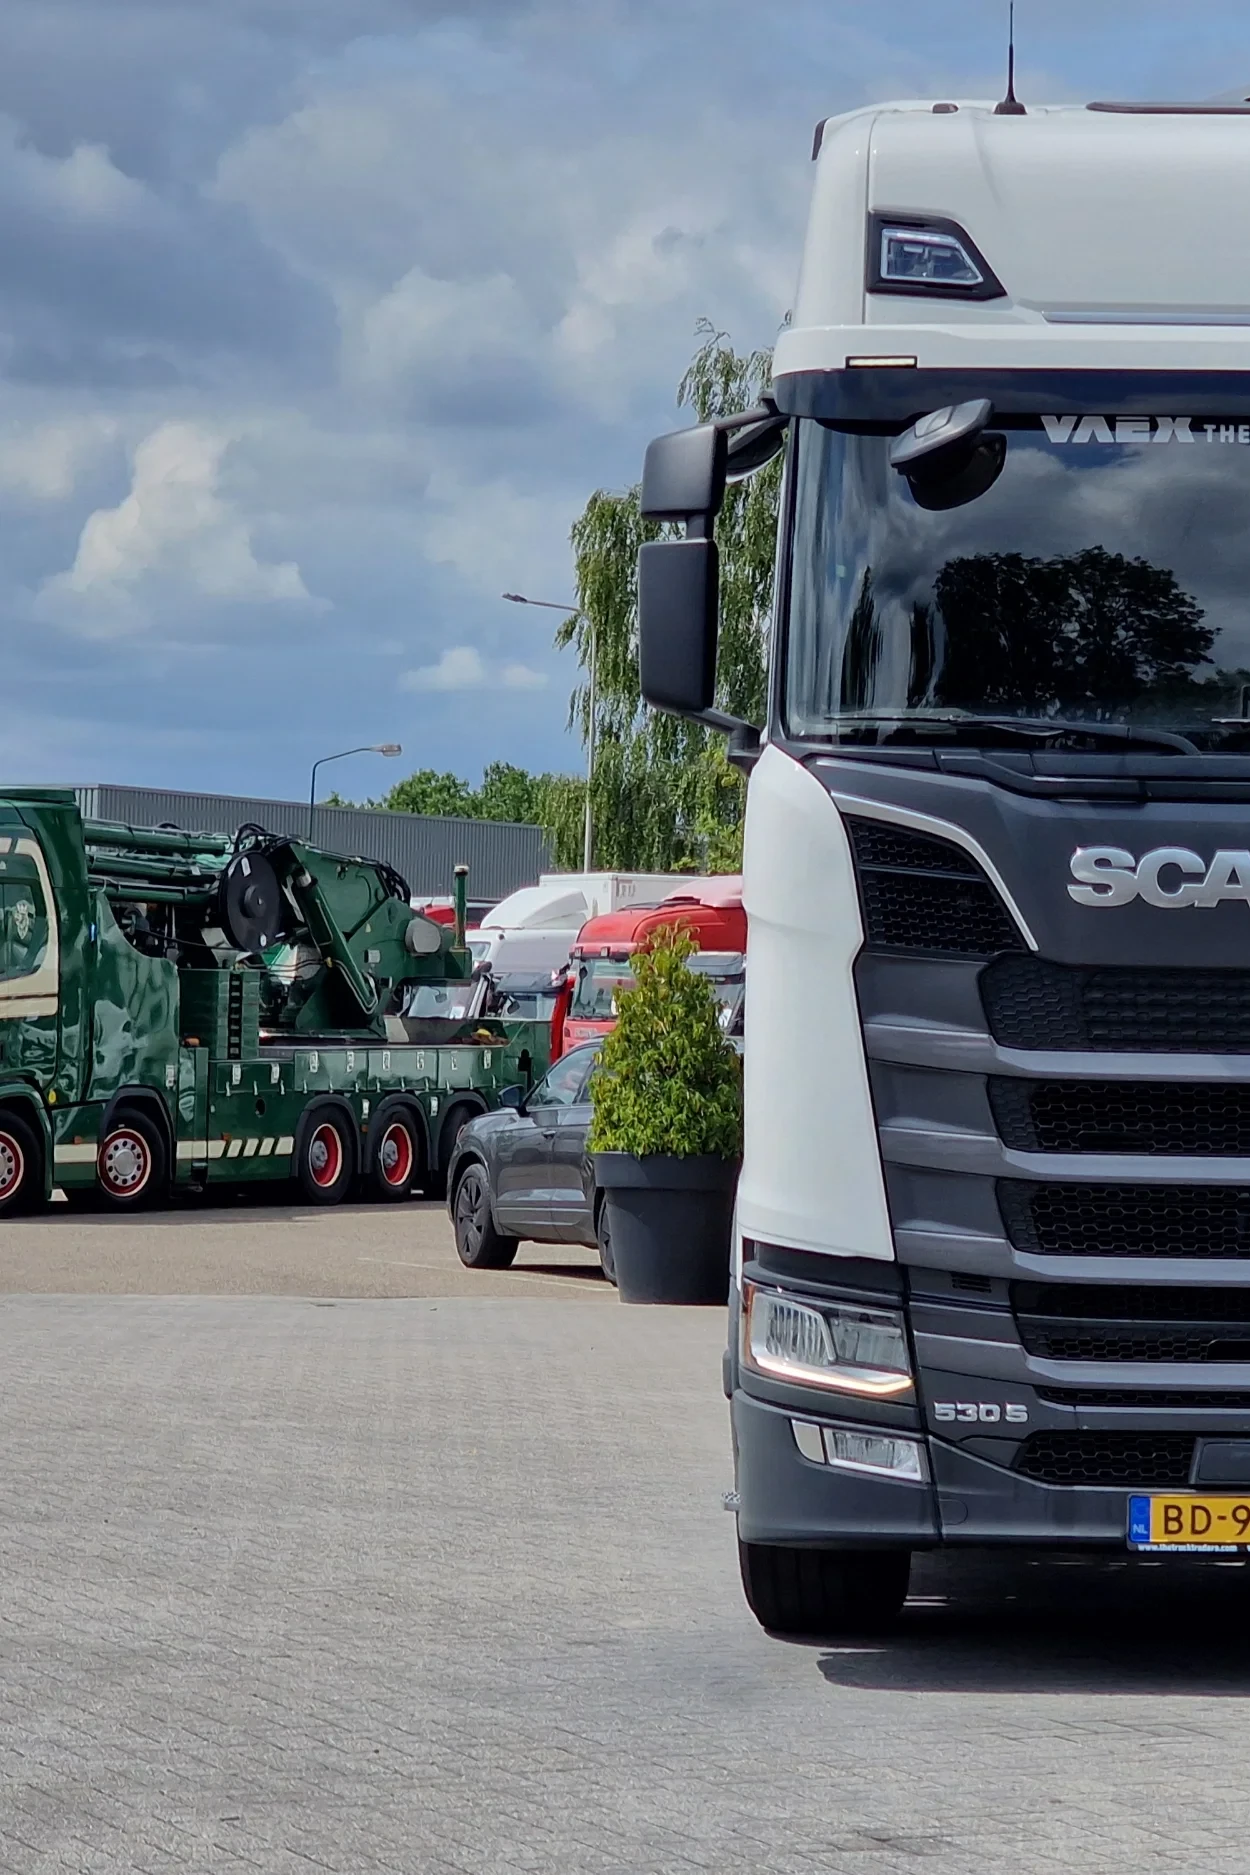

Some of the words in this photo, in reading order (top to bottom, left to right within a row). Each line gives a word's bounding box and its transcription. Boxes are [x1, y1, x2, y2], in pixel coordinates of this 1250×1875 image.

[1040, 415, 1195, 443] VAEX
[1203, 424, 1250, 444] THE
[933, 1401, 1000, 1422] 530
[1005, 1402, 1028, 1423] S
[1132, 1523, 1148, 1534] NL
